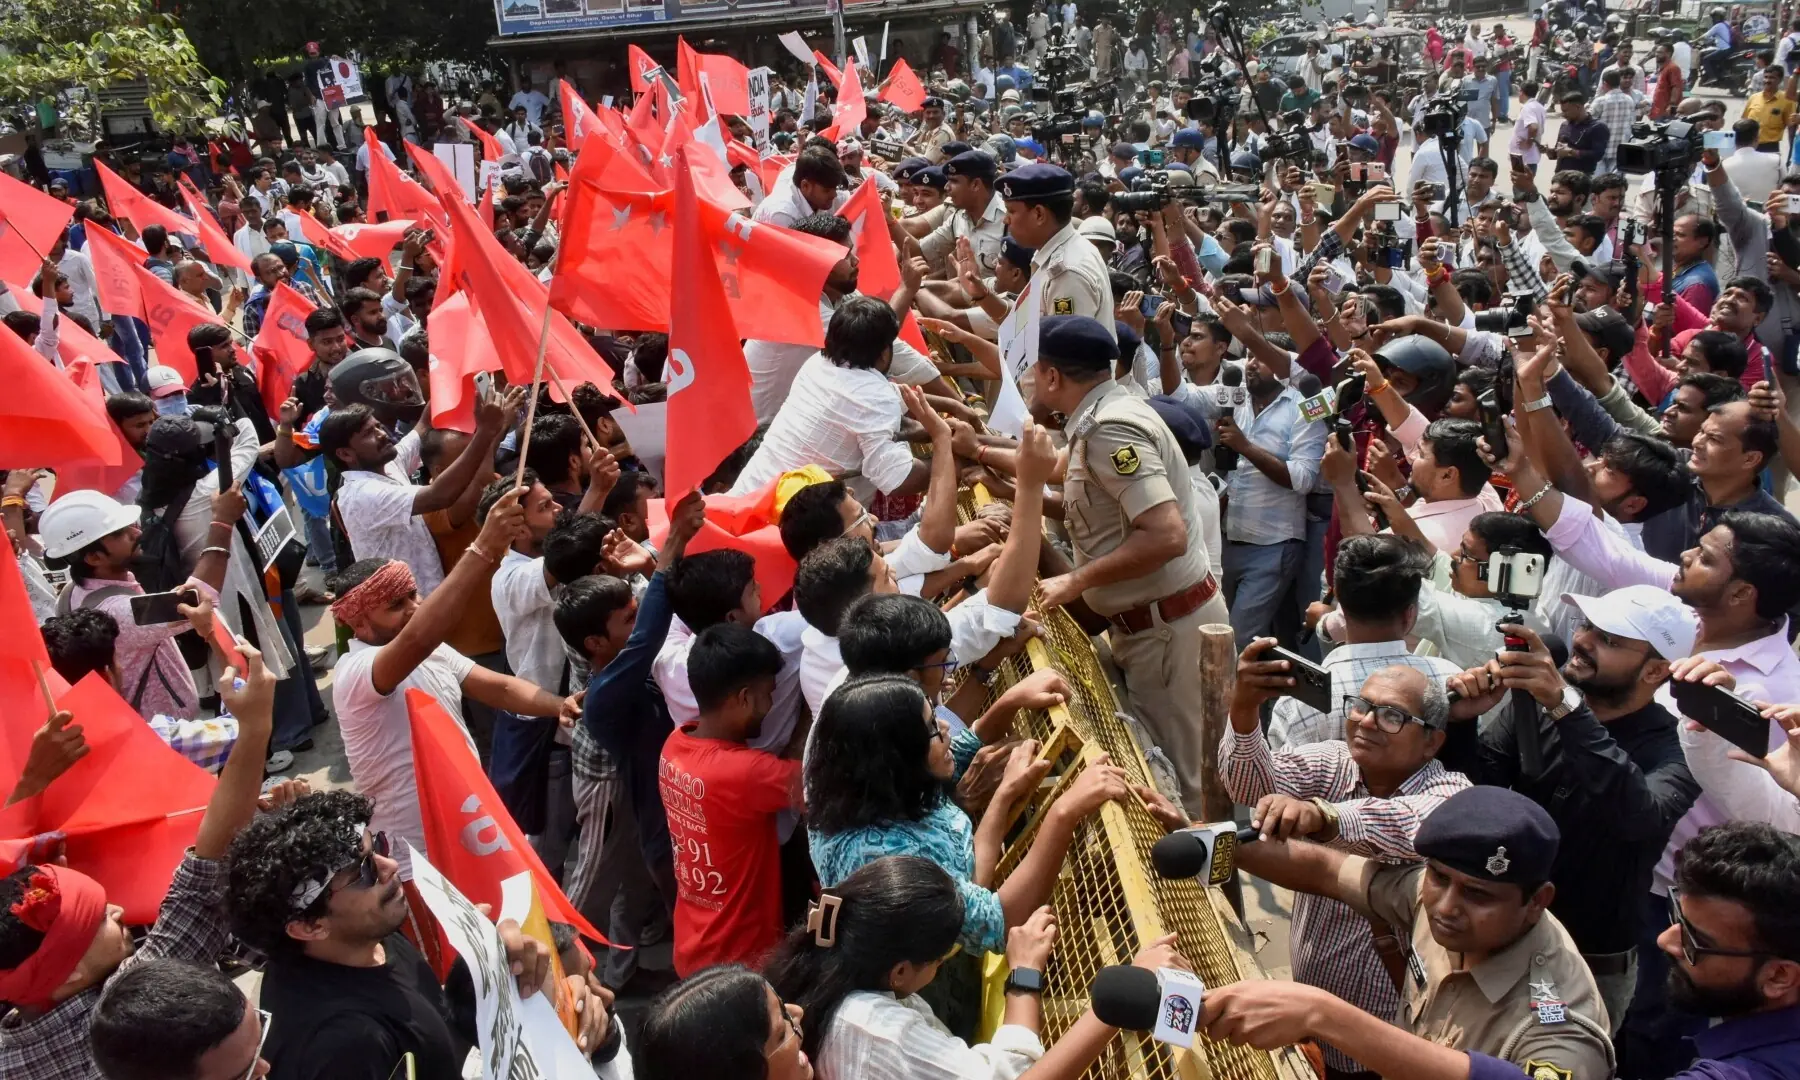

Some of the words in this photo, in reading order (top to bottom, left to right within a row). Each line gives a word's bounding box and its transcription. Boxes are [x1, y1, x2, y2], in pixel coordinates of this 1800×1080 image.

[893, 75, 914, 97] isa
[1660, 630, 1676, 647] NIKE
[688, 837, 715, 868] 91
[1212, 838, 1225, 879] KBC
[1222, 834, 1233, 876] GROUP
[692, 867, 728, 895] 92
[1173, 1010, 1185, 1031] 24
